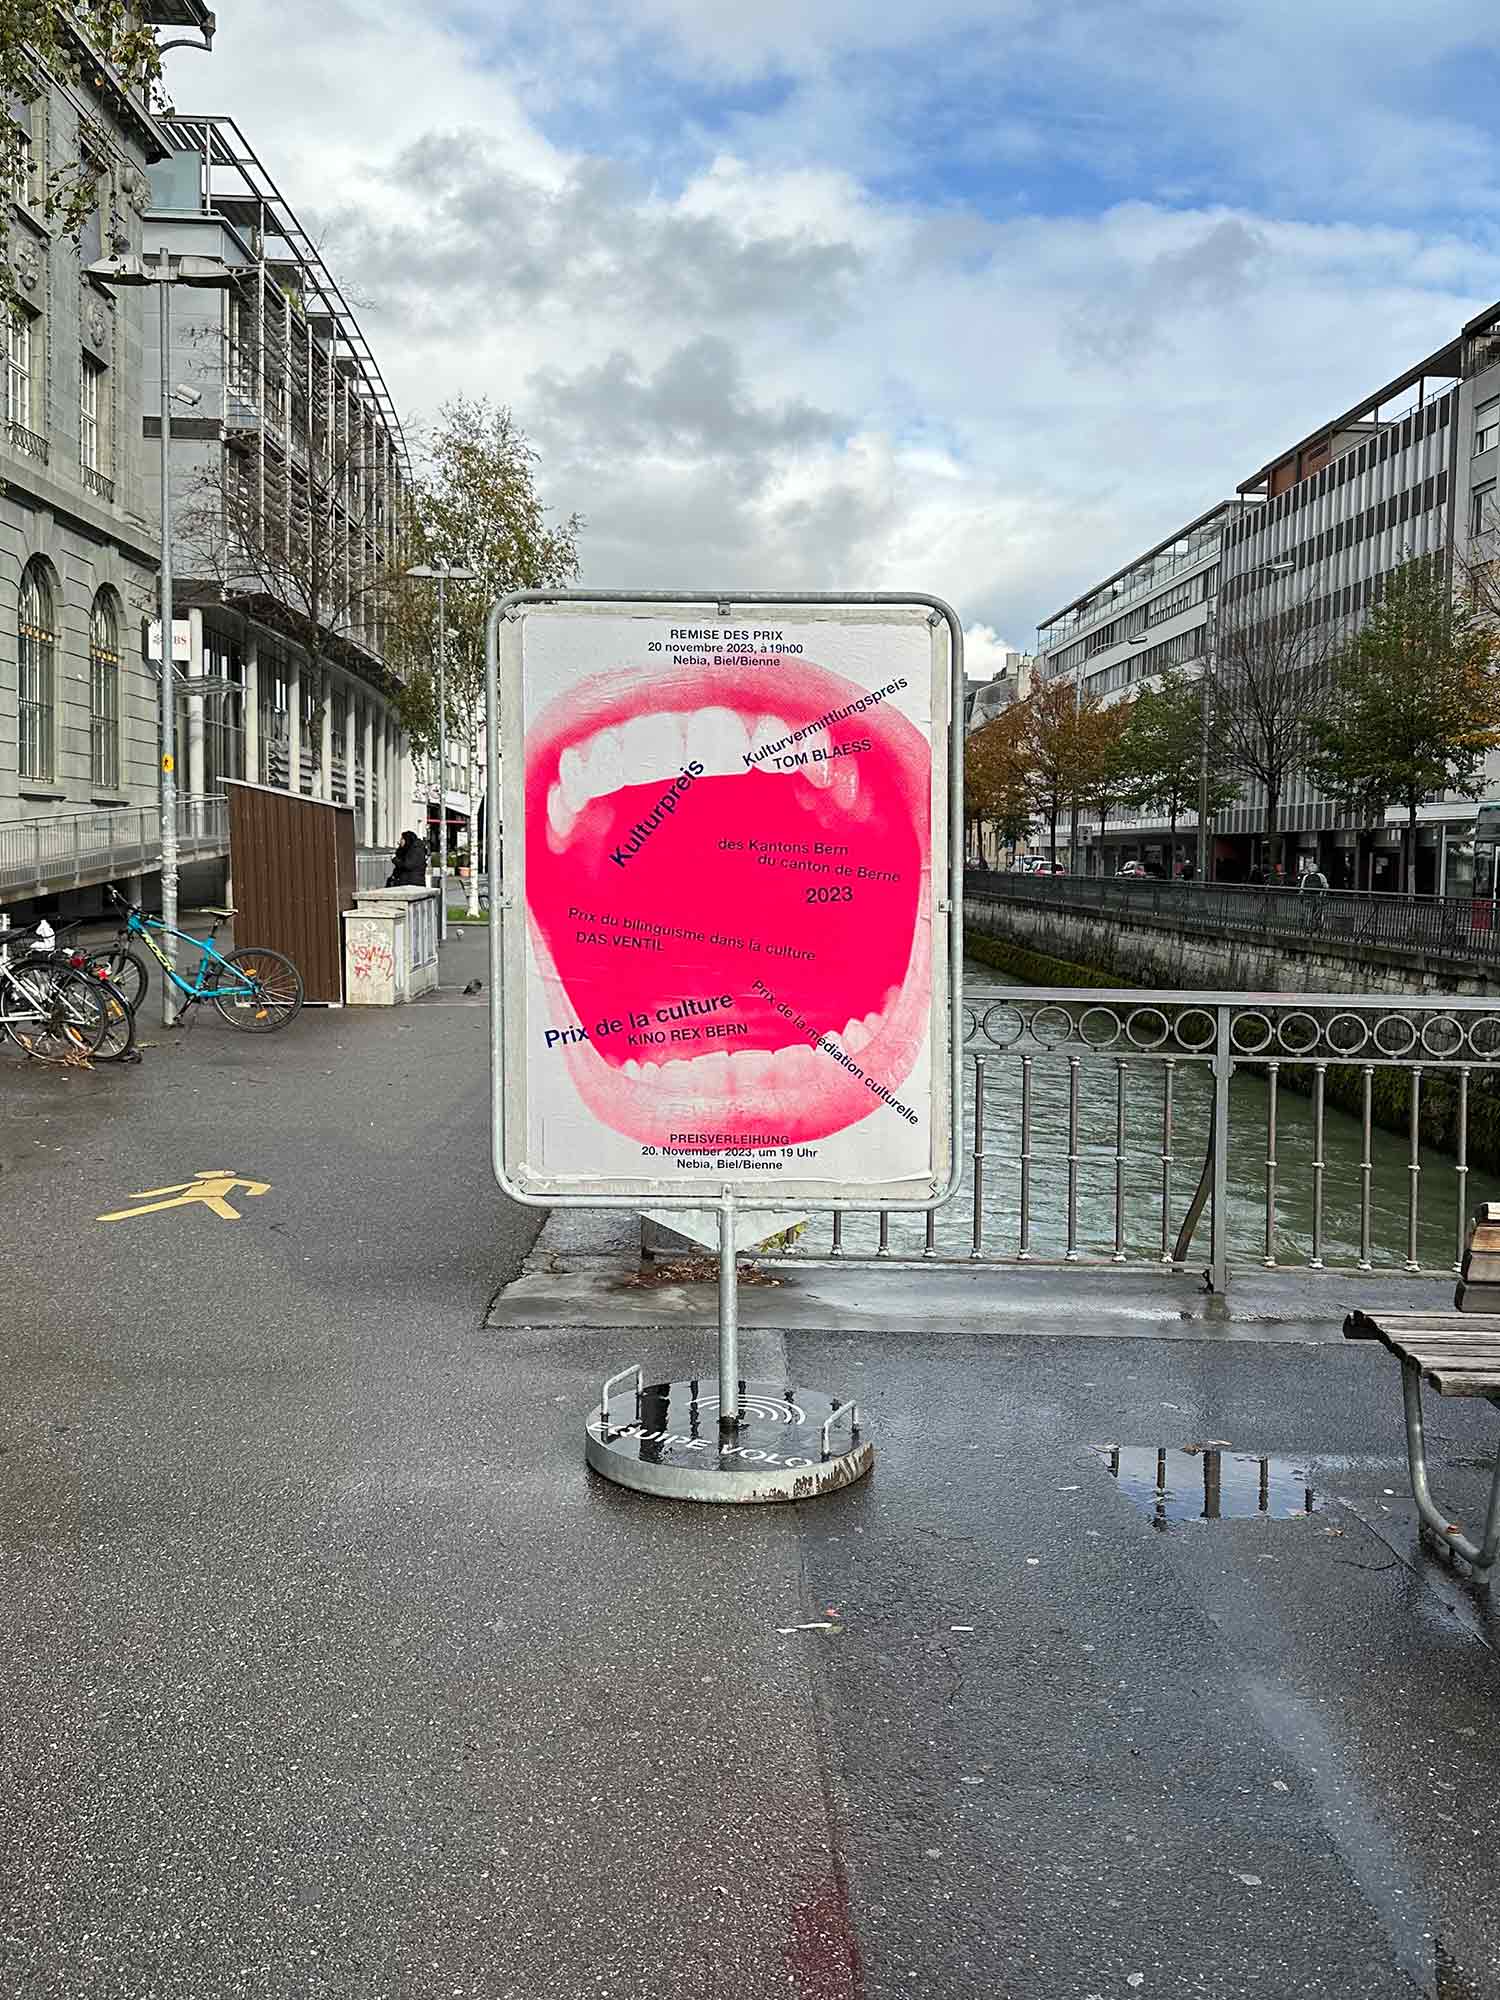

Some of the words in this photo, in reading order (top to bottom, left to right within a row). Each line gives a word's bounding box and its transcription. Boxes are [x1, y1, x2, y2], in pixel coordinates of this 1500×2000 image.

[671, 629, 719, 640] REMISE
[723, 630, 749, 640] DES
[754, 631, 783, 641] PRIX
[648, 642, 662, 652] 20
[665, 643, 722, 653] novembre
[726, 643, 757, 654] 2023,
[760, 643, 767, 653] à
[770, 644, 803, 654] 19h00
[673, 655, 711, 667] Nebia,
[714, 656, 781, 666] Biel/Bienne
[742, 678, 908, 767] Kulturvermittlungspreis
[772, 753, 808, 769] TOM
[812, 739, 872, 762] BLAESS
[608, 760, 704, 868] Kulturpreis
[718, 838, 744, 850] des
[749, 839, 809, 854] Kantons
[814, 842, 848, 856] Bern
[758, 854, 776, 866] du
[780, 859, 830, 873] canton
[834, 865, 852, 877] de
[857, 867, 900, 882] Berne
[806, 886, 853, 904] 2023
[568, 907, 596, 923] Prix
[601, 914, 619, 927] du
[624, 917, 705, 941] bilinguisme
[710, 933, 744, 949] dans
[749, 940, 761, 952] la
[766, 943, 816, 960] culture
[576, 931, 608, 945] DAS
[612, 935, 664, 951] VENTIL
[544, 1026, 589, 1048] Prix
[595, 1019, 623, 1036] de
[629, 1012, 650, 1029] la
[656, 993, 735, 1023] culture
[628, 1032, 666, 1046] KINO
[671, 1027, 700, 1041] REX
[705, 1023, 748, 1038] BERN
[752, 980, 776, 1004] Prix
[776, 1001, 793, 1019] de
[793, 1016, 806, 1030] la
[806, 1027, 864, 1080] médiation
[864, 1077, 919, 1125] culturelle
[670, 1133, 790, 1145] PREISVERLEIHUNG
[641, 1146, 658, 1156] 20.
[662, 1146, 722, 1157] November
[725, 1147, 754, 1158] 2023,
[758, 1148, 777, 1157] um
[781, 1147, 793, 1157] 19
[797, 1148, 818, 1158] Uhr
[677, 1159, 713, 1171] Nebia,
[717, 1159, 783, 1170] Biel/Bienne
[587, 1420, 713, 1450] EQUIPE
[720, 1444, 813, 1469] VOLO
